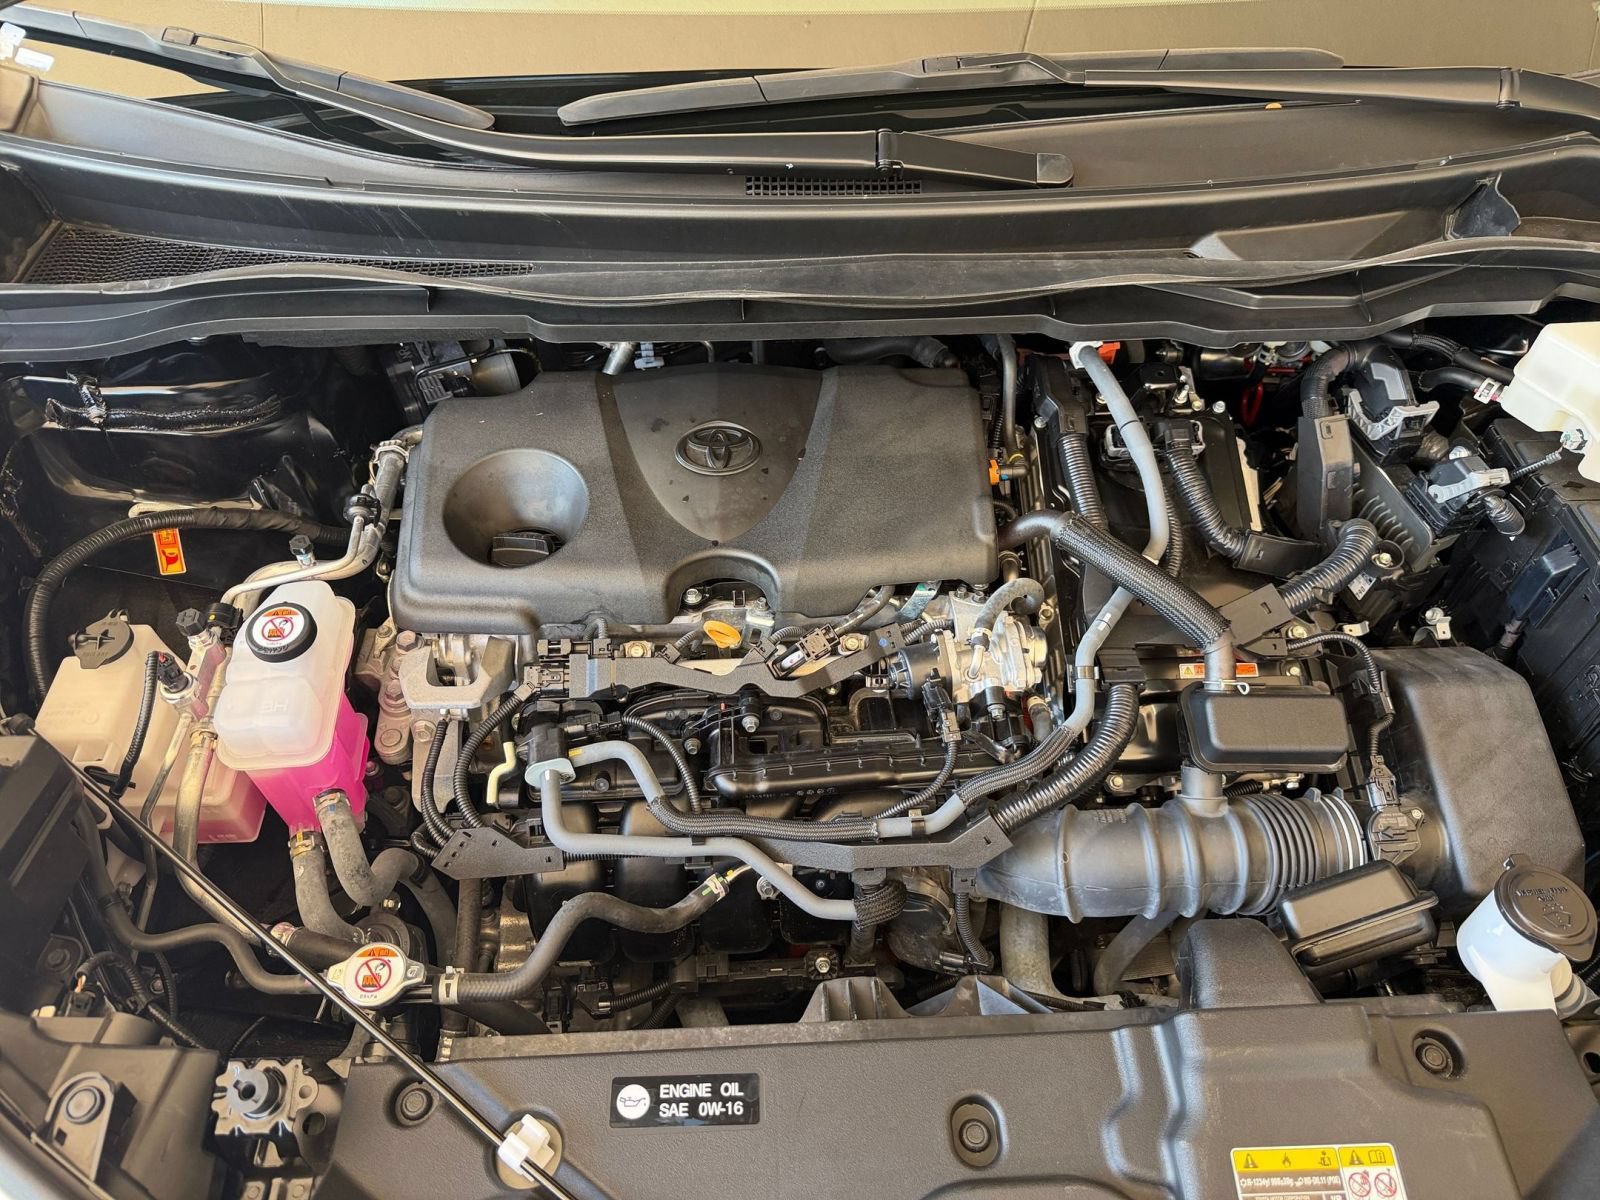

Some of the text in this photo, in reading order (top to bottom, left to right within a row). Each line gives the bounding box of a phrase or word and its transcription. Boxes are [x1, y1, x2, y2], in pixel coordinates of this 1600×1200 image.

[659, 1082, 744, 1099] ENGINE OIL
[659, 1101, 744, 1118] SAE 0W-16
